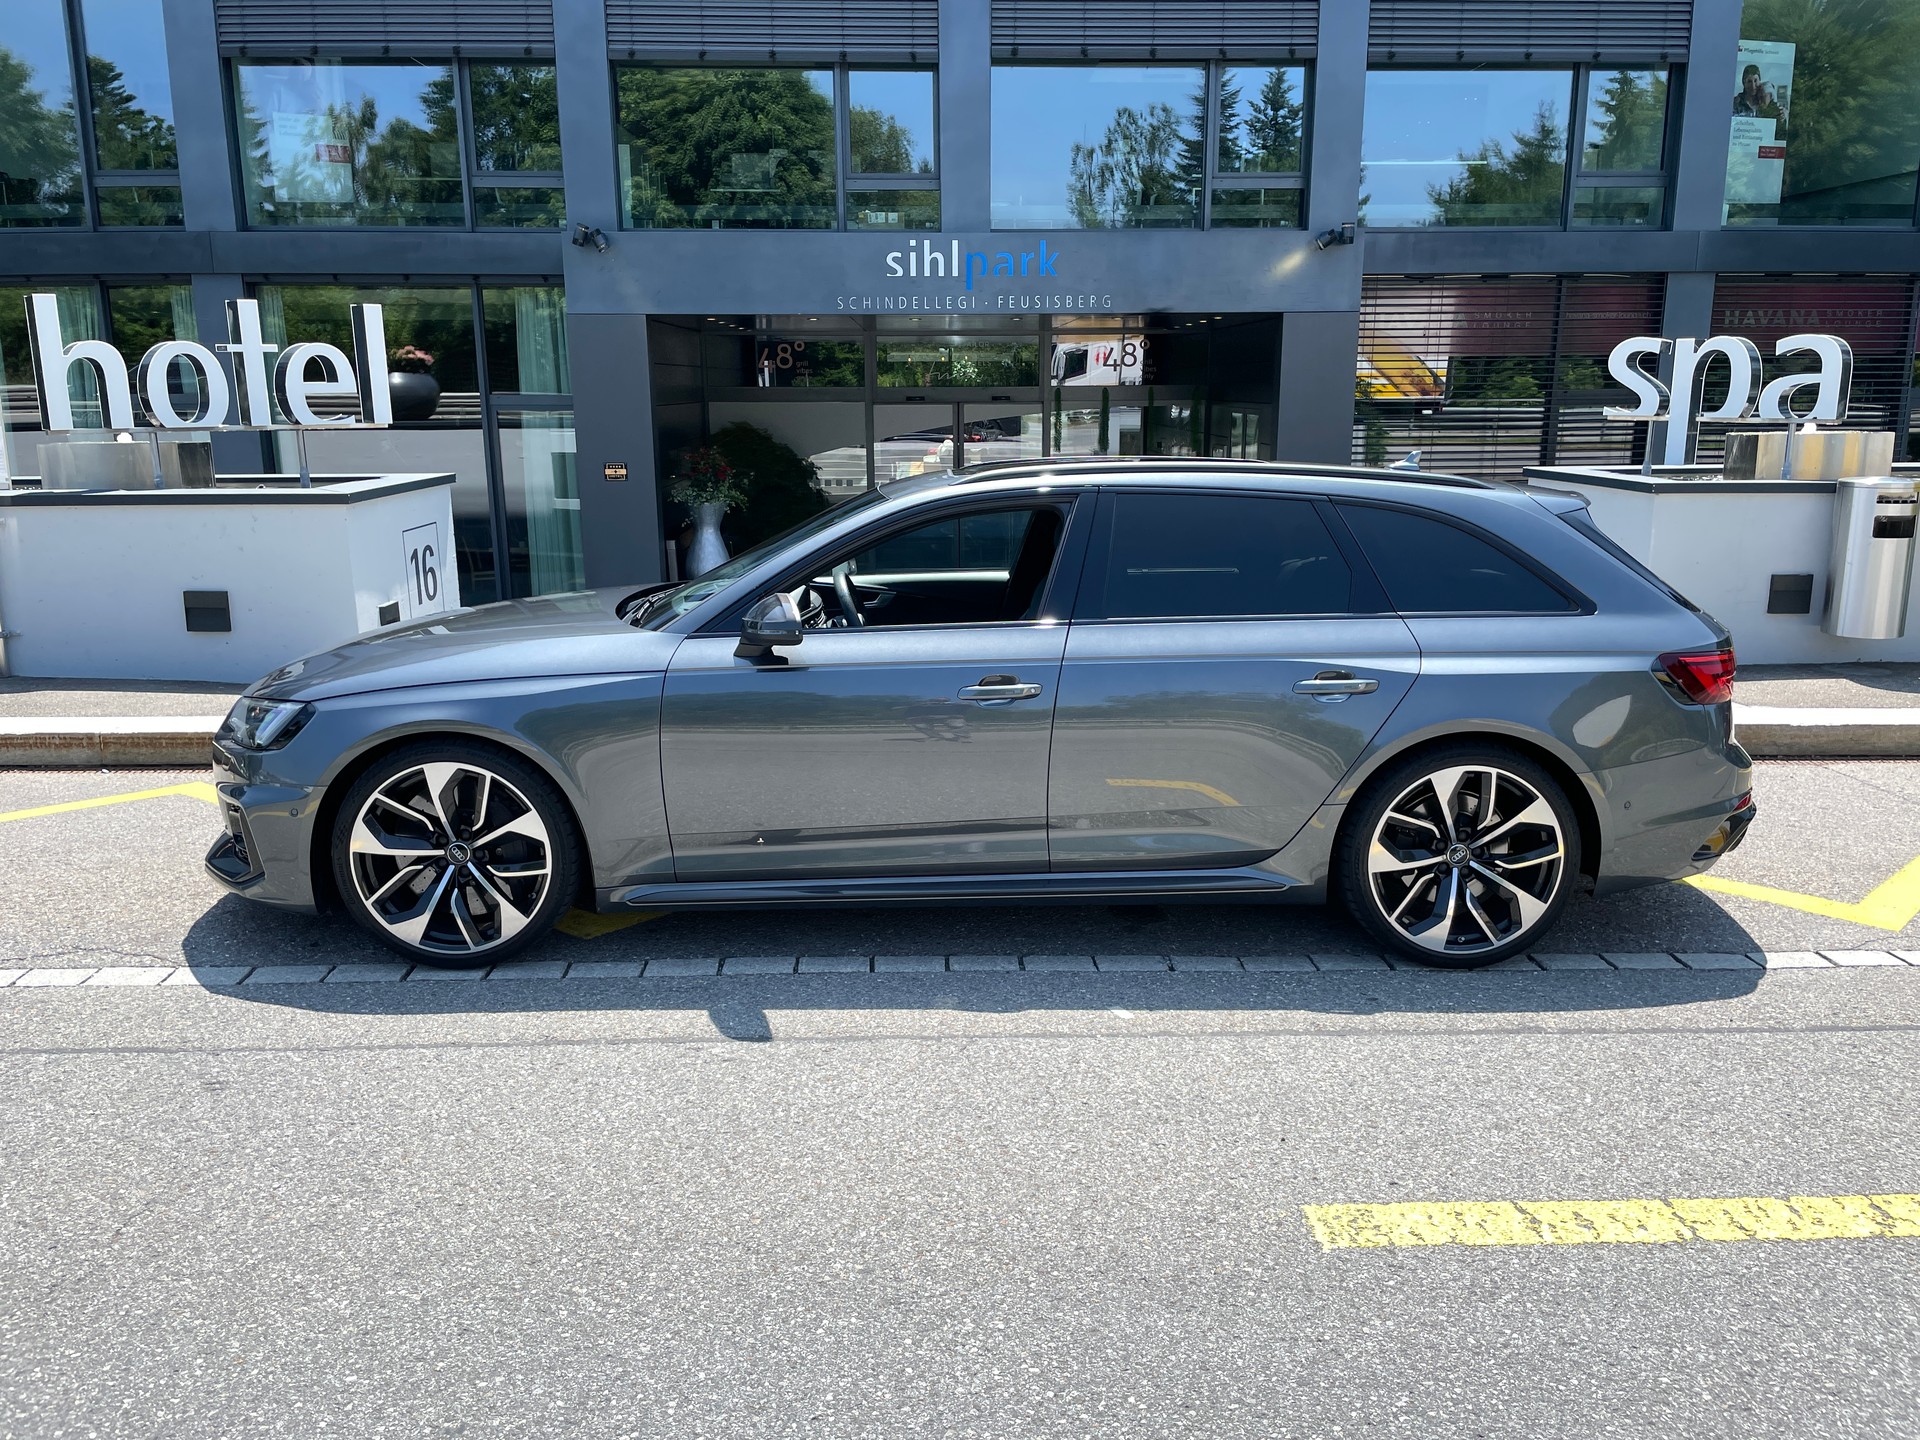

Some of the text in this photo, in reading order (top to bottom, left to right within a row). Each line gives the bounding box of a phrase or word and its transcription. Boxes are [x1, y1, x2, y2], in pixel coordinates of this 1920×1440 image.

[886, 239, 1060, 290] sihlpark
[837, 294, 1112, 309] SCHINDELLEGI FEUSISBERG
[1723, 310, 1820, 328] HAVANA
[1825, 309, 1884, 317] SMOKER
[24, 293, 392, 431] hotel
[1102, 339, 1150, 372] 48°
[1603, 334, 1853, 465] spa
[410, 544, 438, 605] 16
